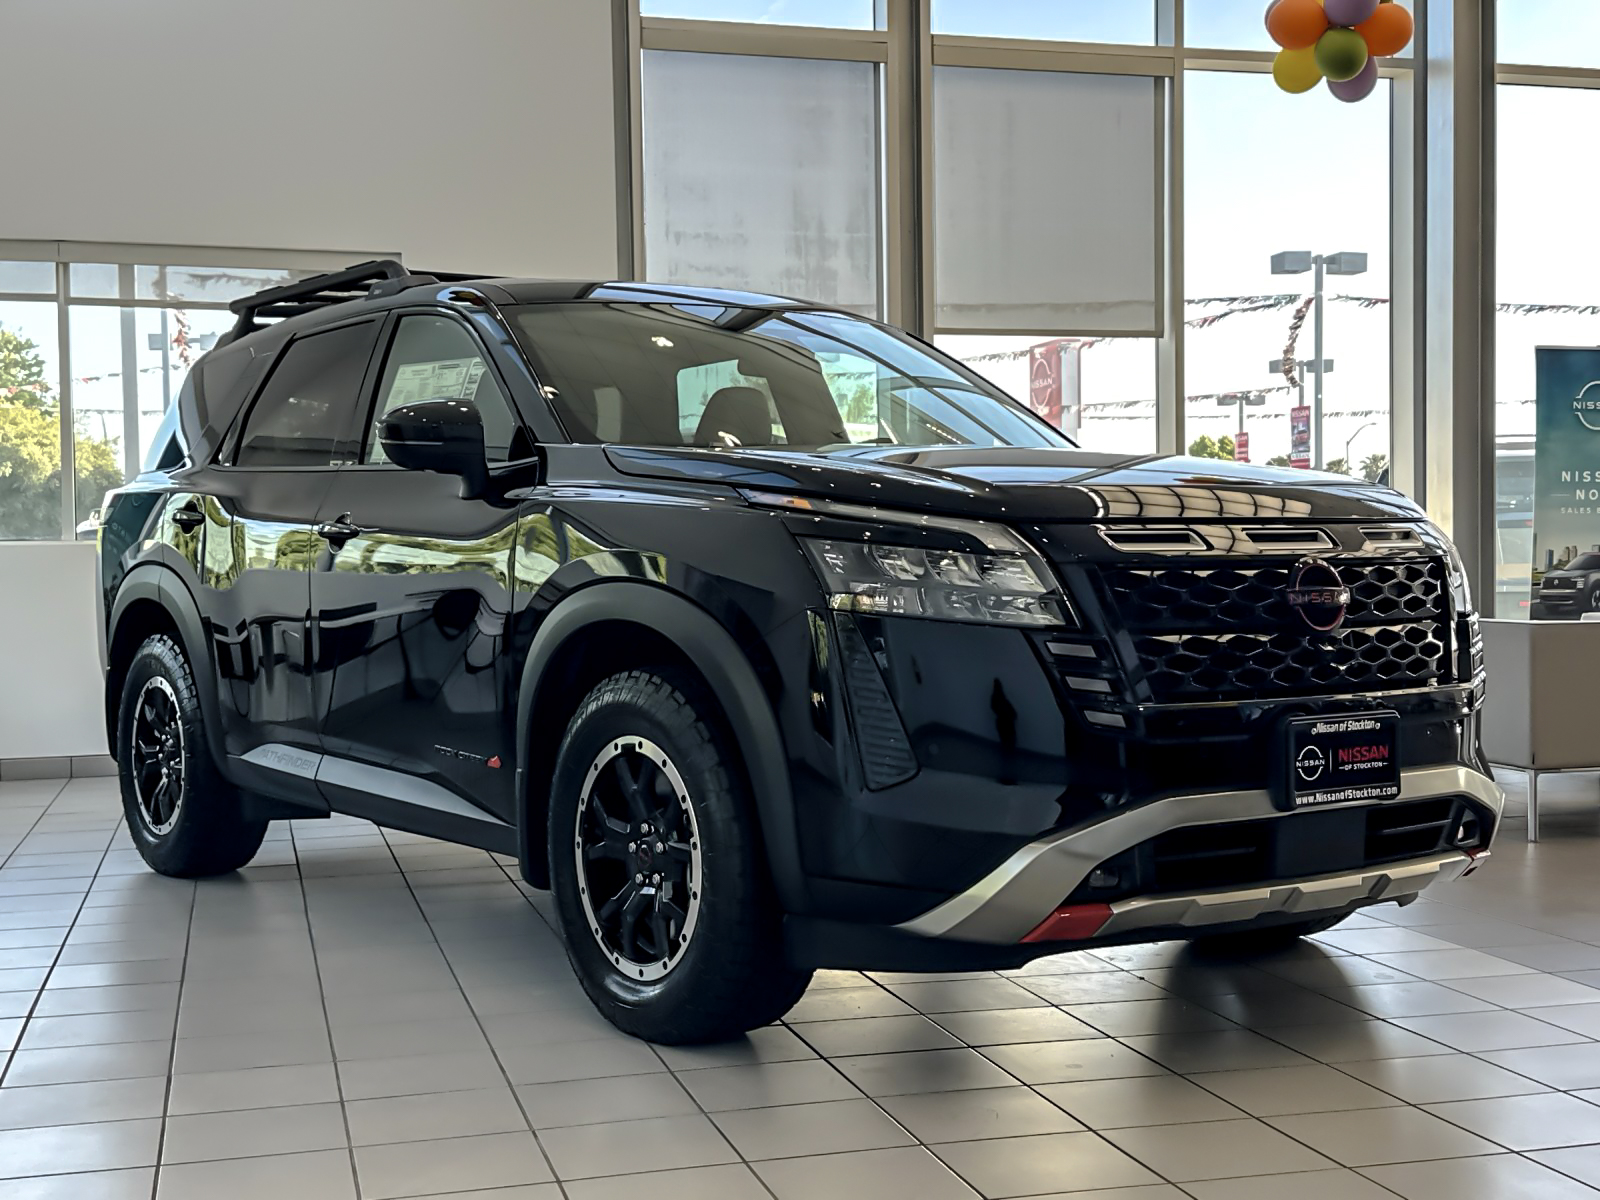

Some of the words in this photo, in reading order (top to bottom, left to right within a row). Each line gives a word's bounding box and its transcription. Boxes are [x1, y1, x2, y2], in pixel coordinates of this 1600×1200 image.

[1576, 489, 1599, 500] NO
[1316, 722, 1339, 734] Nissan
[1339, 723, 1348, 732] of
[1347, 719, 1375, 731] Stockton
[1338, 745, 1389, 763] NISSAN
[1296, 759, 1325, 768] NISSAN
[1353, 761, 1383, 770] STOCKTON
[1295, 786, 1398, 805] www.NissanofStockton.com
